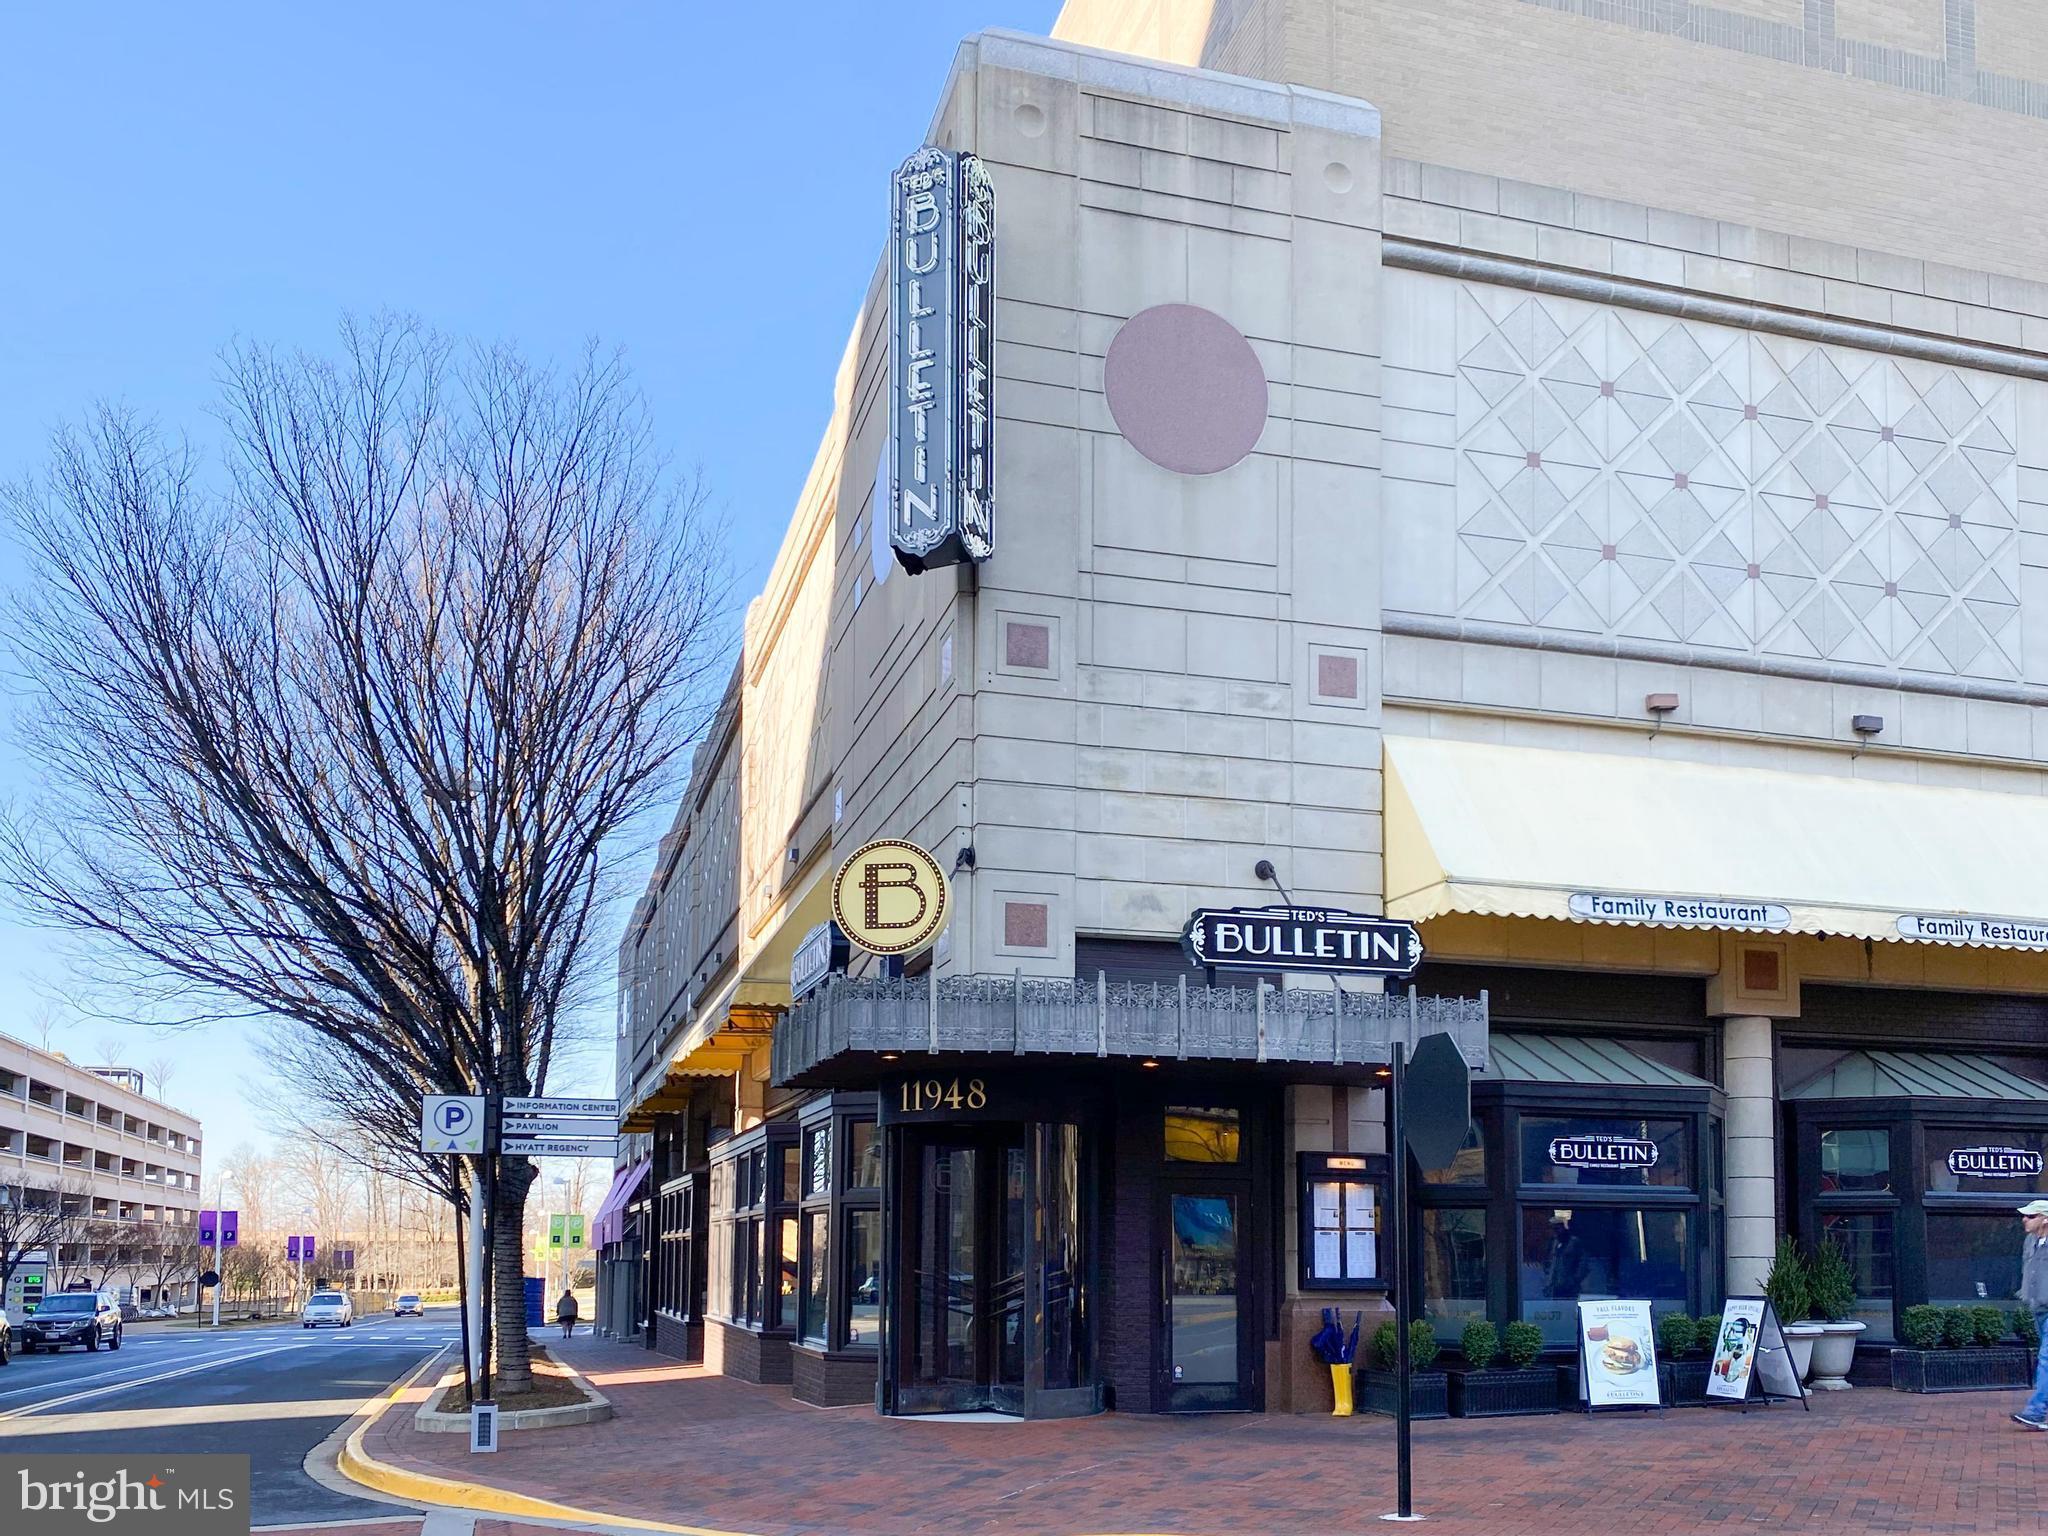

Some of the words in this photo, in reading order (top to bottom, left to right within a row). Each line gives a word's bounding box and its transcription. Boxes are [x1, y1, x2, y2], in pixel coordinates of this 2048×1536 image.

[905, 191, 941, 528] BULLETIN
[859, 863, 927, 929] B
[1290, 910, 1325, 922] TED'S
[1592, 897, 1657, 919] Family
[1665, 901, 1767, 921] Restaurant
[1917, 918, 1974, 940] Family
[1981, 922, 2048, 942] Restaur
[1215, 923, 1400, 961] BULLETIN
[900, 1078, 987, 1112] 11948
[446, 1107, 465, 1129] P
[516, 1102, 580, 1111] INFORMATION
[582, 1104, 616, 1112] CENTER
[516, 1122, 559, 1131] PAVILION
[515, 1143, 544, 1151] HYATT
[548, 1144, 590, 1152] REGENCY
[1560, 1144, 1648, 1161] BULLETIN
[1958, 1154, 2034, 1170] BULLETIN
